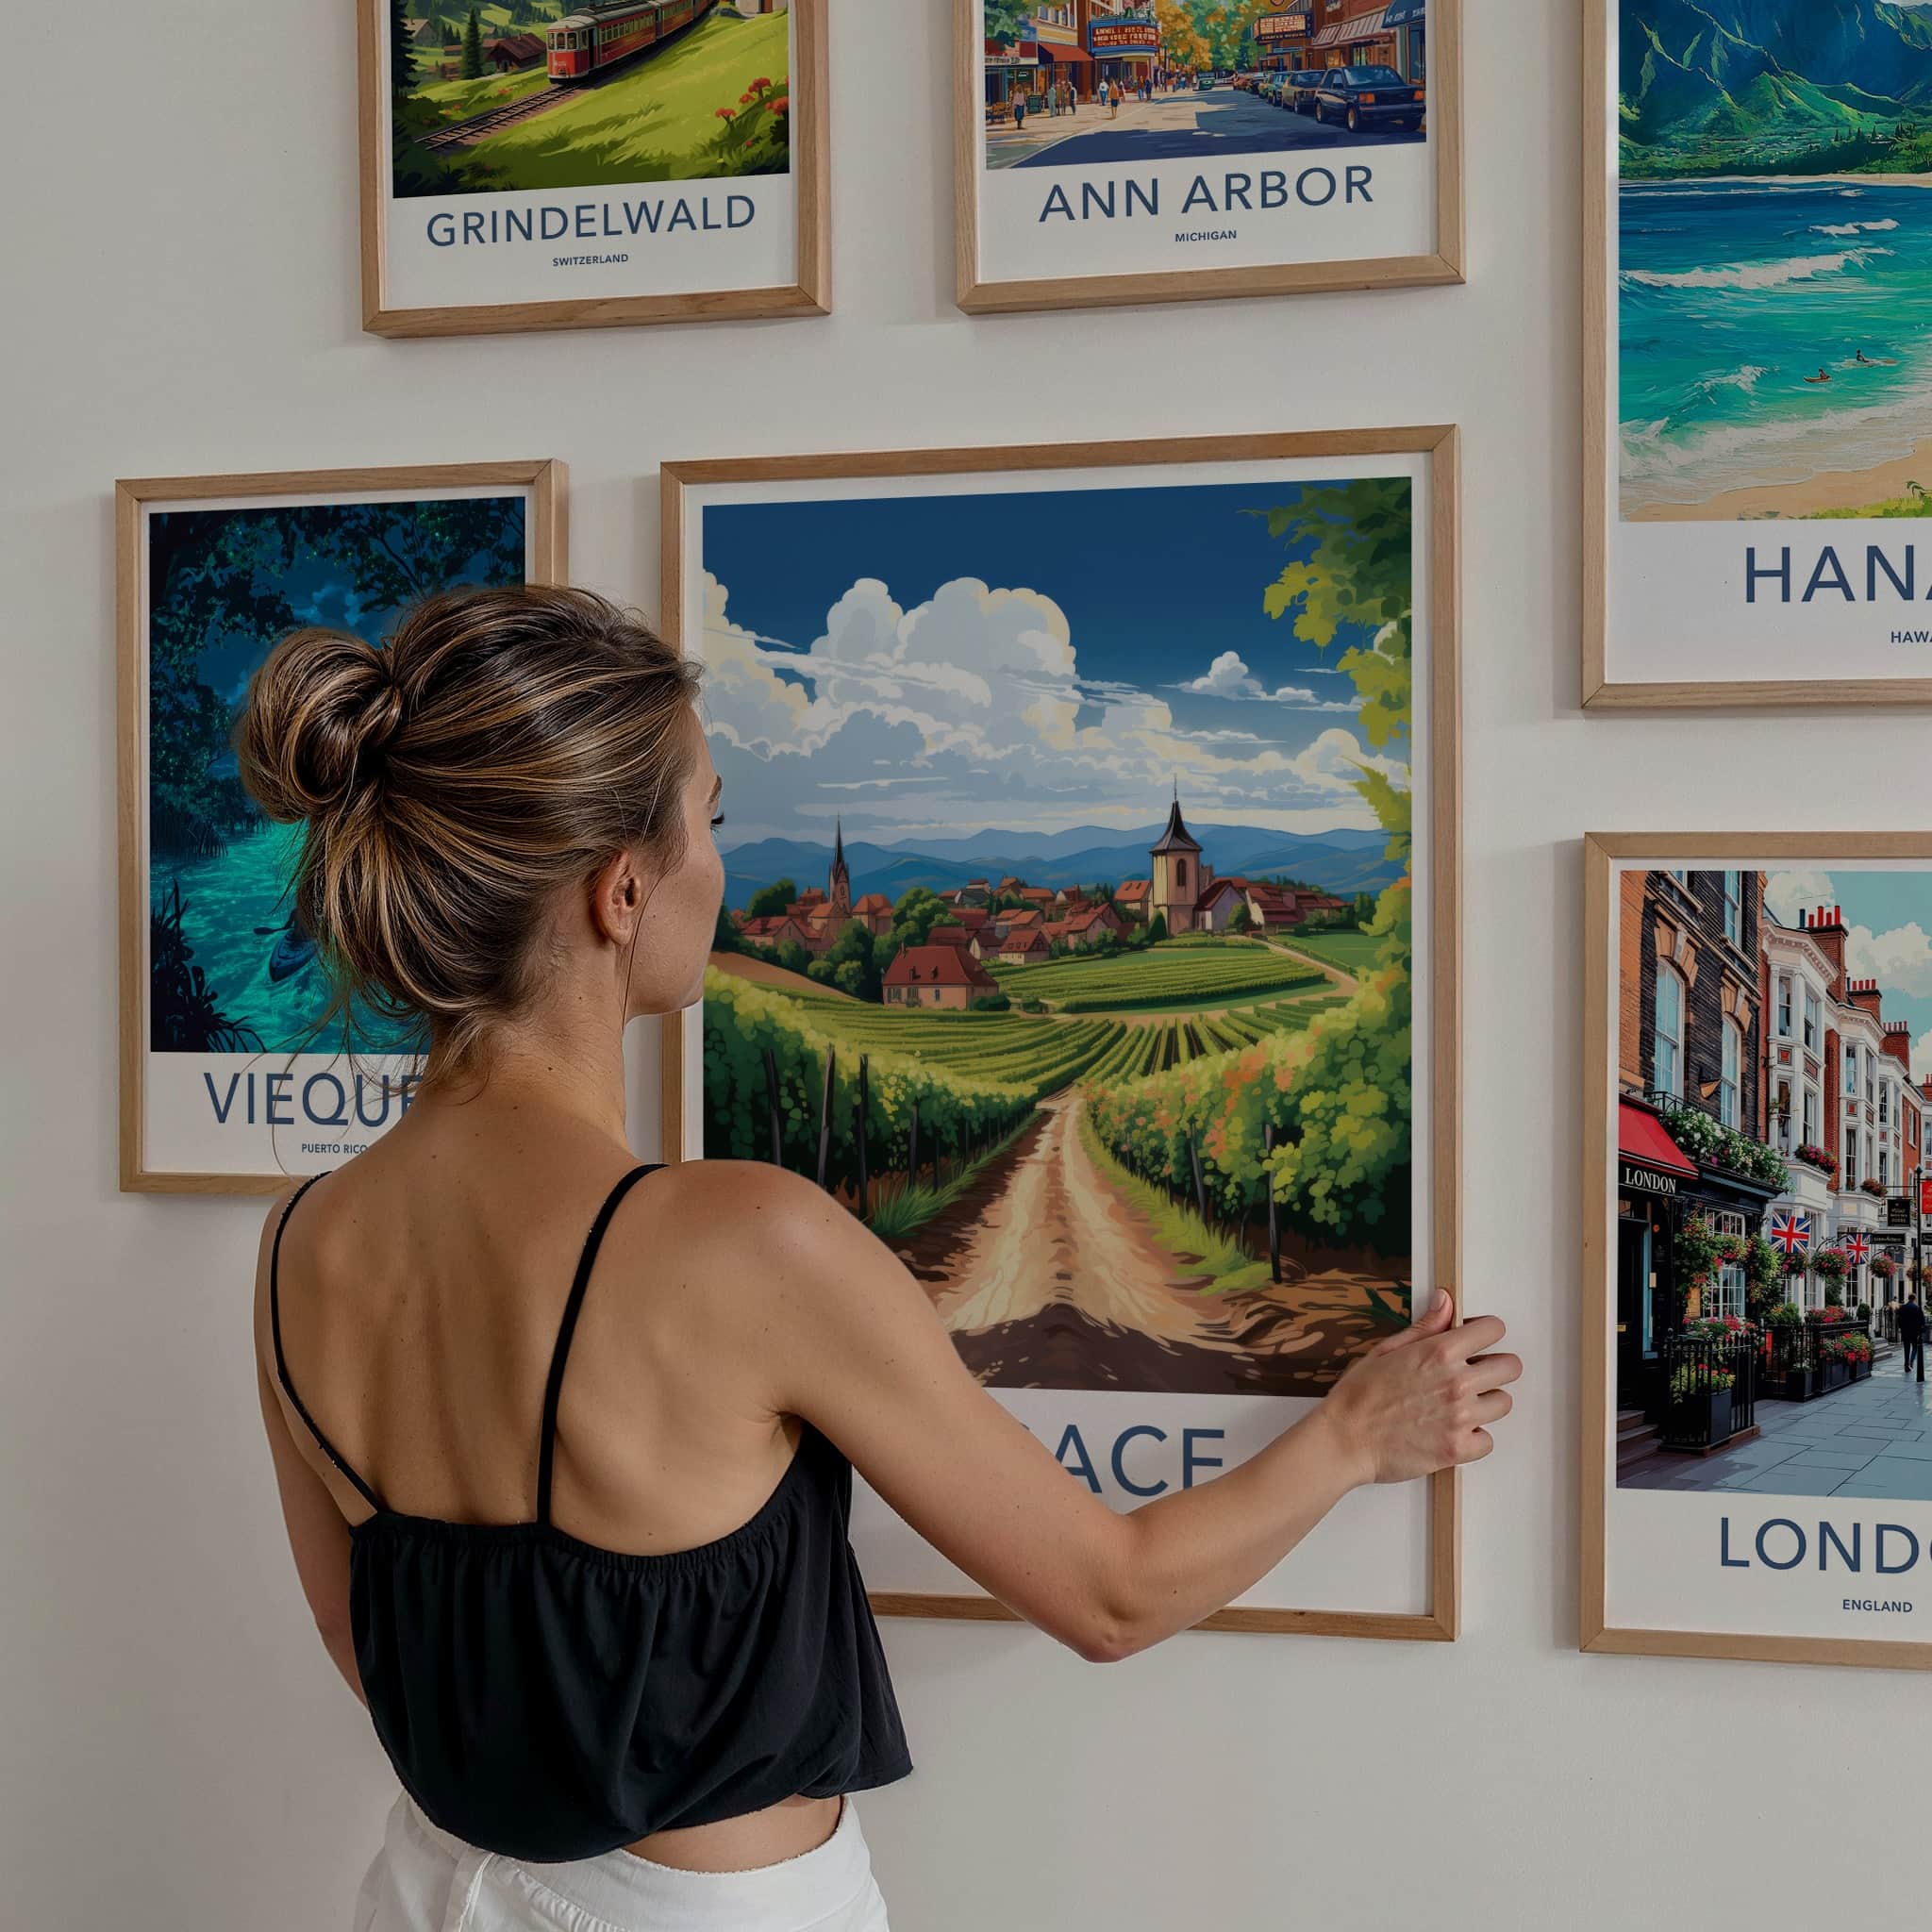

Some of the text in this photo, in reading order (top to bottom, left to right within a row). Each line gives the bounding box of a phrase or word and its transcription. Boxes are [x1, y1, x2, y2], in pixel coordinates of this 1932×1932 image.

[1039, 164, 1374, 223] ANN ARBOR
[425, 194, 755, 247] GRINDELWALD
[1174, 230, 1238, 242] MICHIGAN
[553, 254, 629, 267] SWITZERLAND
[1745, 544, 1932, 604] HAN
[301, 1143, 341, 1154] PUERTO
[1624, 1167, 1676, 1194] LONDON
[1020, 1423, 1225, 1497] ACE
[1720, 1517, 1932, 1574] LOND
[1842, 1598, 1914, 1613] ENGLAND
